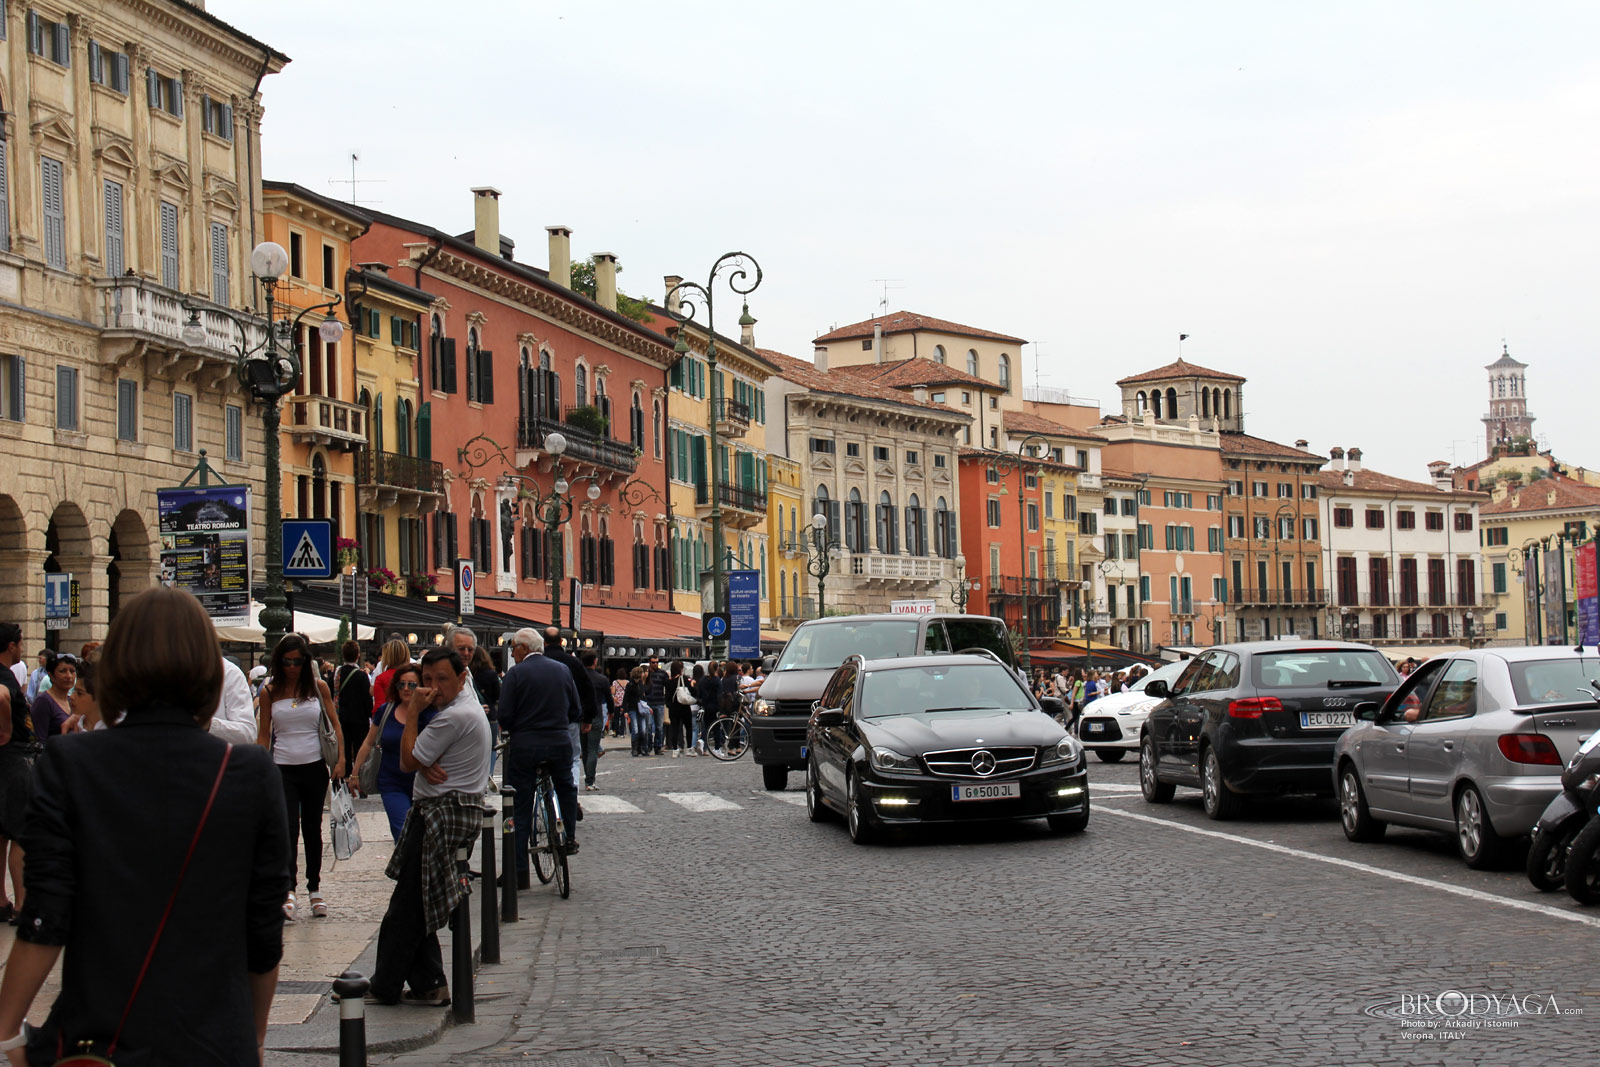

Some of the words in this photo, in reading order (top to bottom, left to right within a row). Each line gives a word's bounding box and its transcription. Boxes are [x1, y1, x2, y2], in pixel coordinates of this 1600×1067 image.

[212, 521, 239, 529] ROMANO
[47, 619, 68, 628] LOTTO
[1308, 713, 1322, 725] EC
[965, 787, 972, 798] G
[980, 786, 999, 797] 500
[1001, 785, 1013, 796] JL
